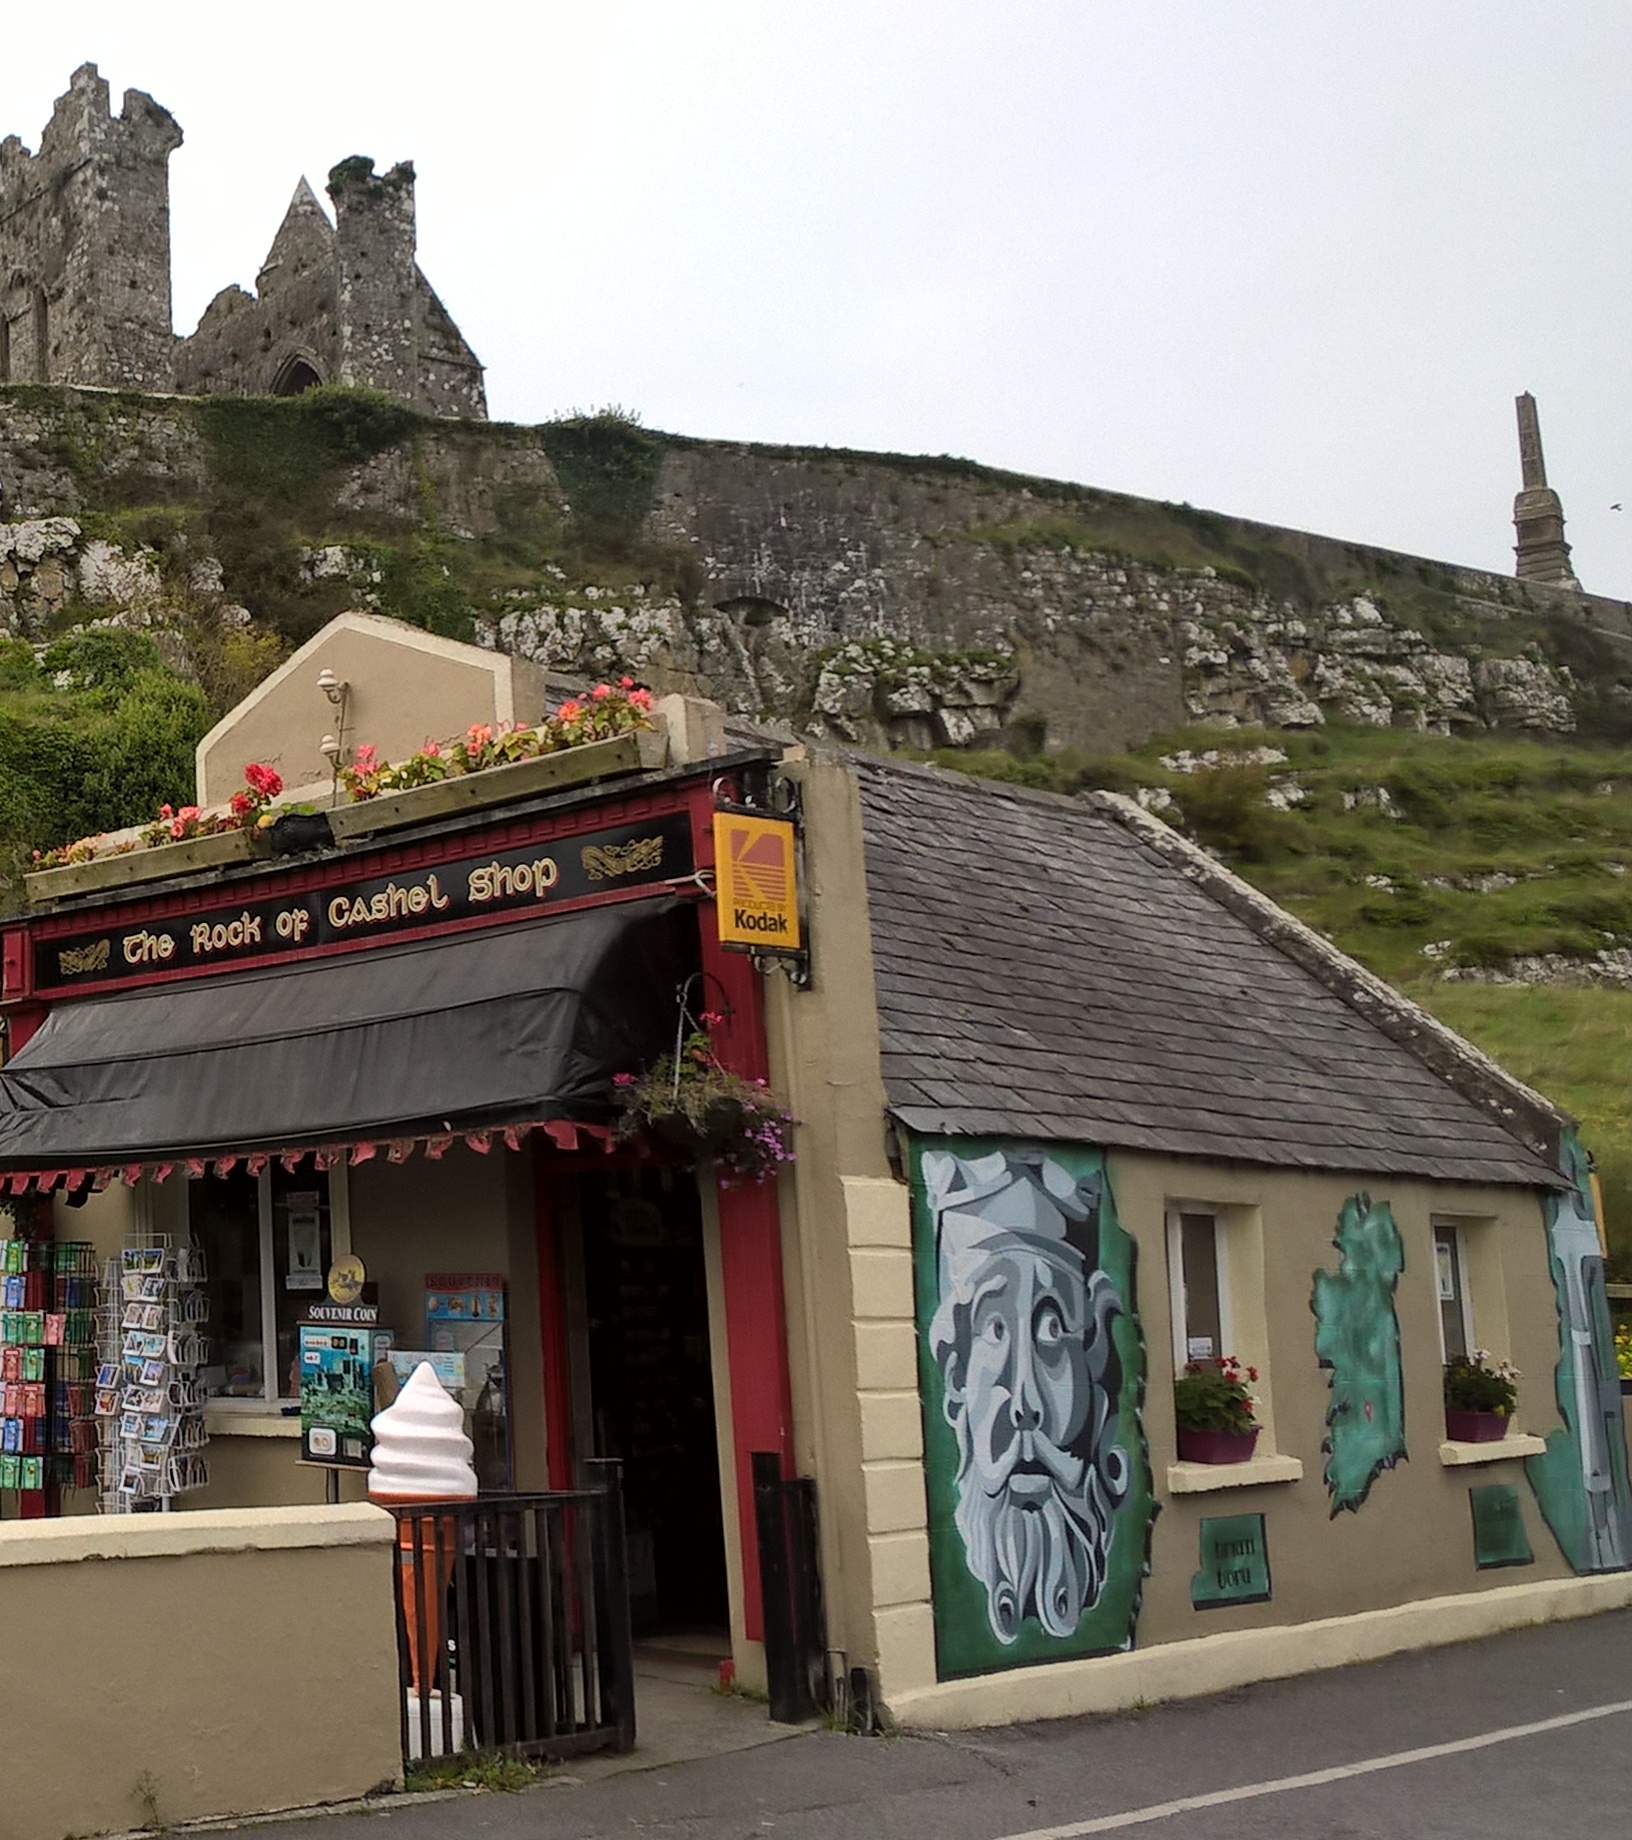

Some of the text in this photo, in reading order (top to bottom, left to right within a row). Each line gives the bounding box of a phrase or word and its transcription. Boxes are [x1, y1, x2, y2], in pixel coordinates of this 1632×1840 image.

[123, 930, 175, 964] The
[190, 911, 261, 953] Rock
[328, 874, 448, 928] Cashel
[468, 857, 558, 902] Shop
[734, 909, 788, 933] Kodak
